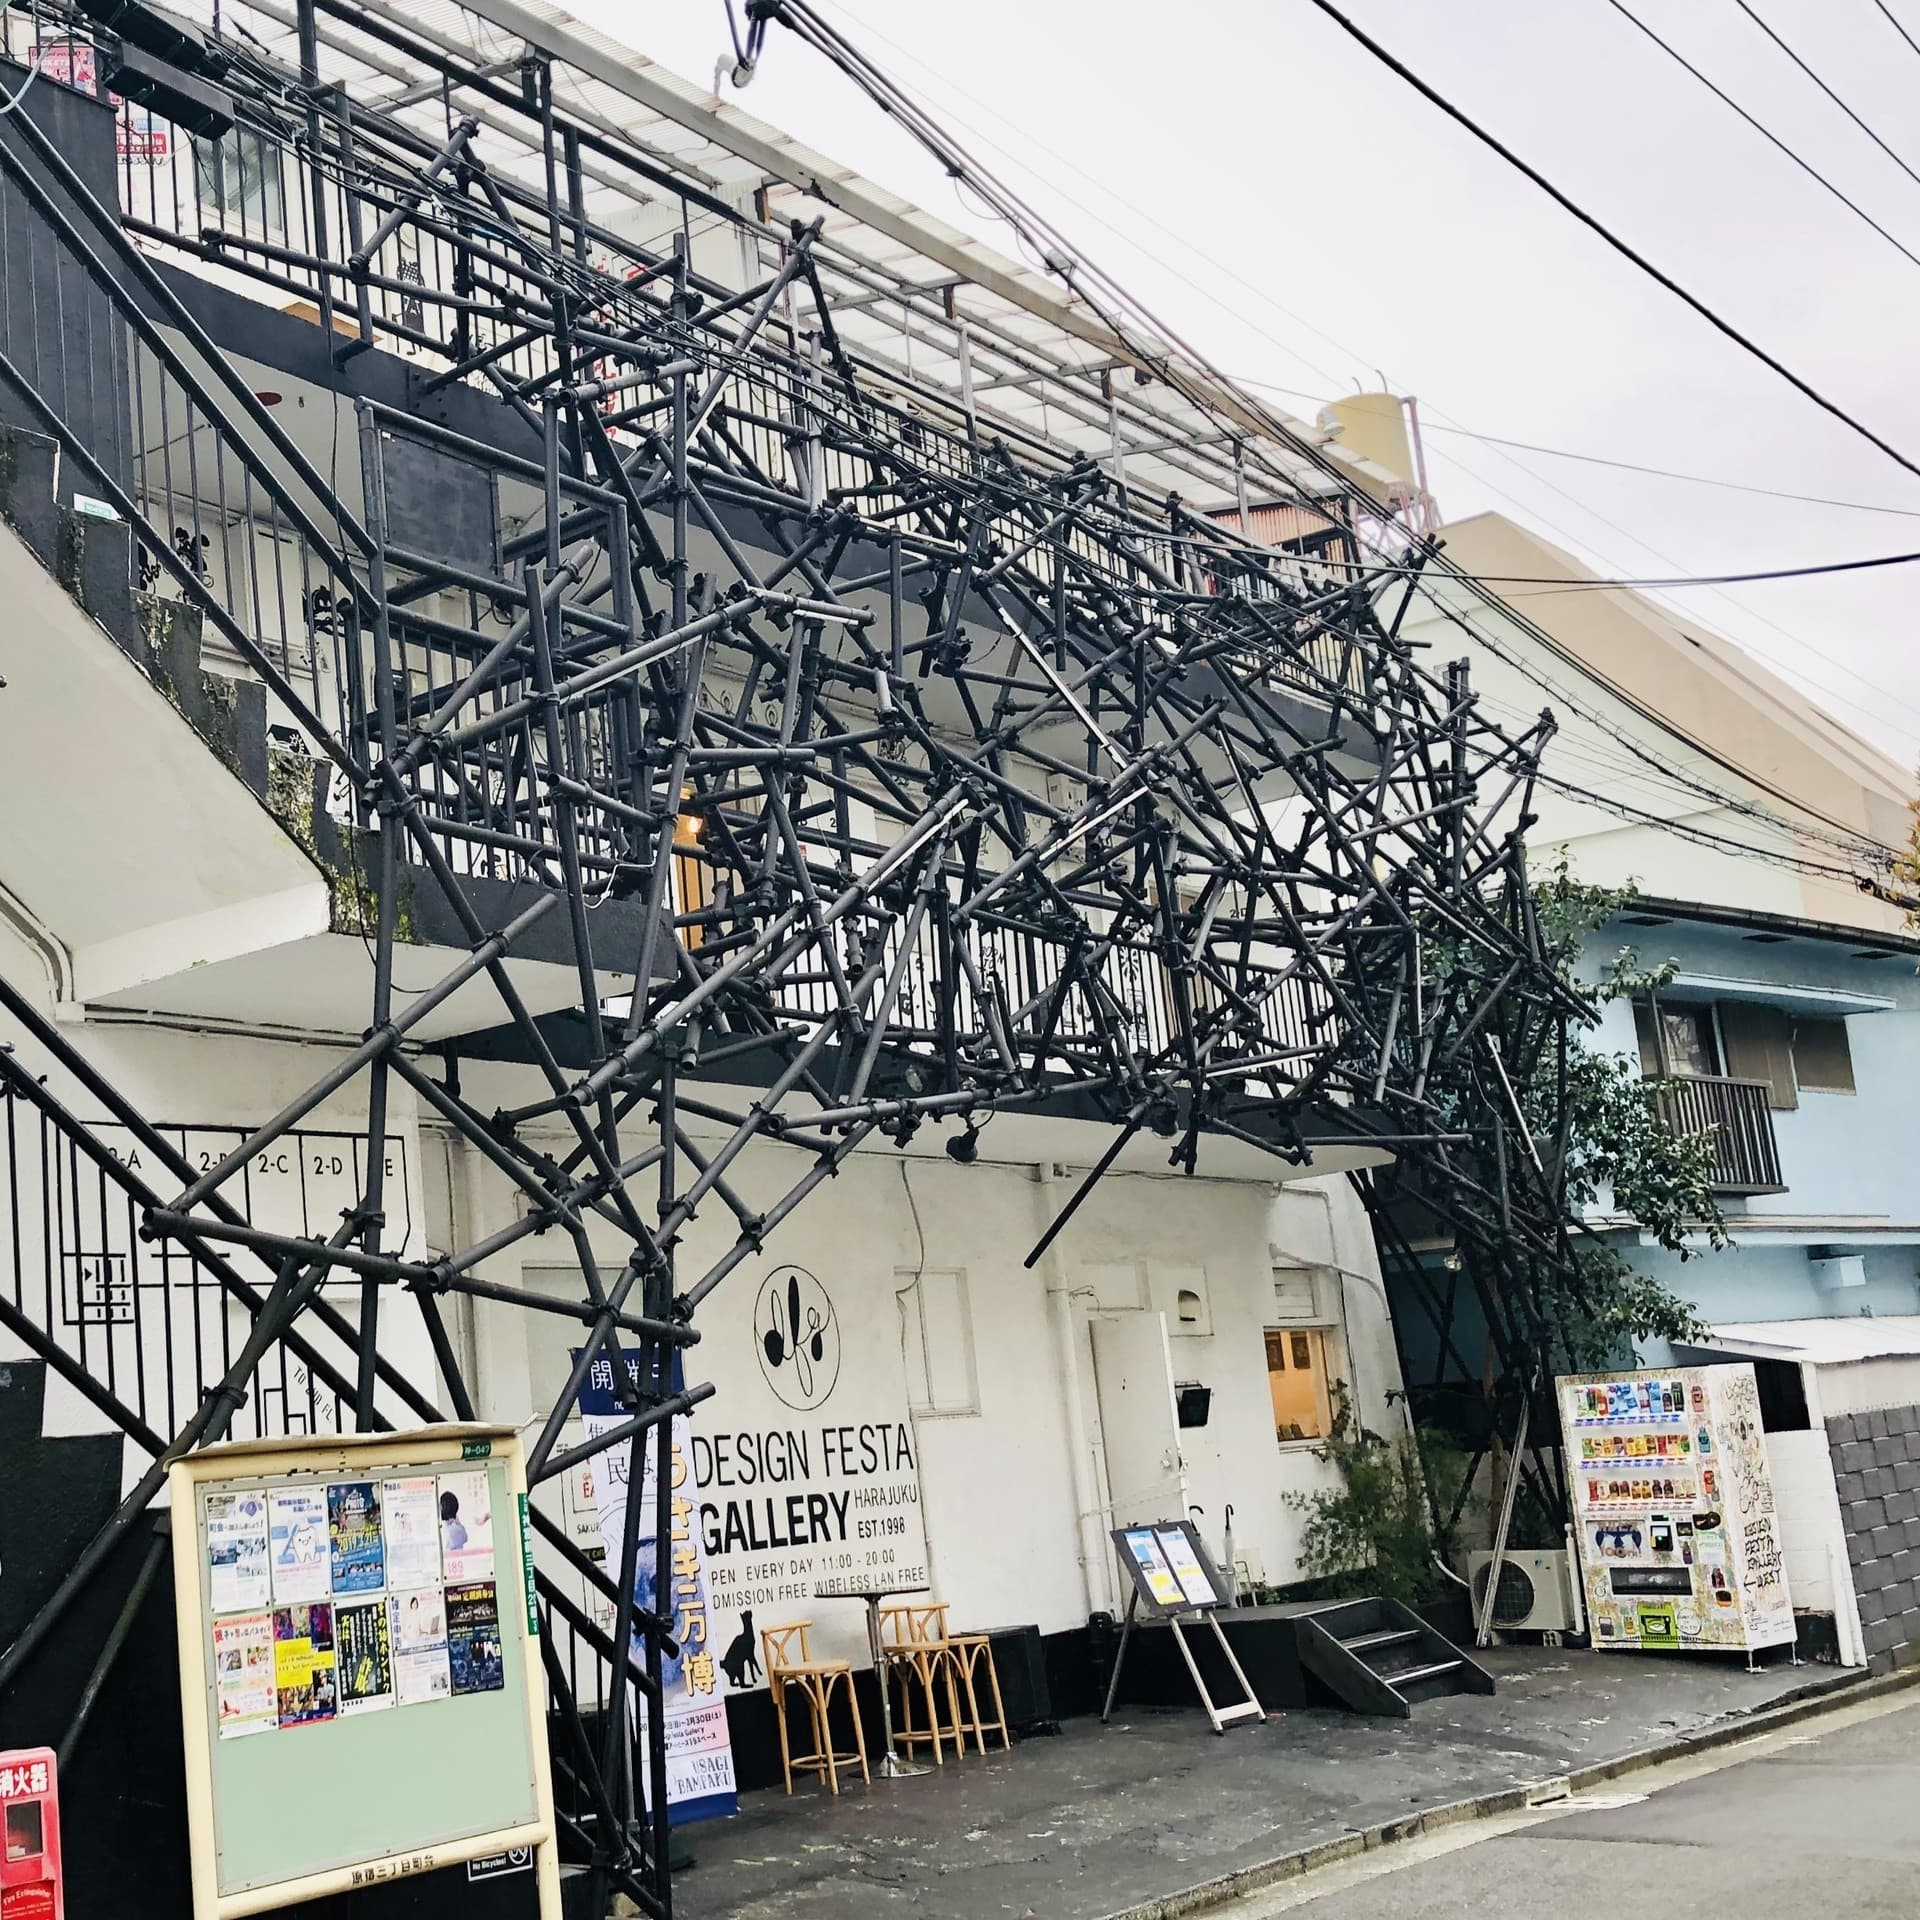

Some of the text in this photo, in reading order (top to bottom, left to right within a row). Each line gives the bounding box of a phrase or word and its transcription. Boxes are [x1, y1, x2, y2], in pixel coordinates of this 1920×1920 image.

[258, 1154, 289, 1174] 2-C
[313, 1156, 343, 1176] 2-D
[293, 1366, 306, 1385] TO
[305, 1388, 322, 1406] ND
[691, 1429, 811, 1488] DESIGN
[822, 1423, 915, 1477] FESTA
[700, 1484, 918, 1557] GALLERY HARAJUKU
[858, 1516, 906, 1539] EST.1998
[711, 1568, 737, 1586] PEN
[746, 1562, 785, 1580] EVERY
[791, 1558, 813, 1575] DAY
[821, 1553, 852, 1570] 11:00
[865, 1548, 896, 1565] 20:00
[712, 1589, 775, 1610] DMISSION
[779, 1583, 808, 1601] FREE
[874, 1572, 895, 1588] LAN
[898, 1567, 925, 1583] FREE
[0, 1762, 49, 1798] 消火器
[692, 1755, 730, 1774] USAGI
[678, 1771, 732, 1795] BAMPAKU
[351, 1855, 435, 1886] 原宿三丁目町会
[472, 1856, 507, 1871] No Bicycles!
